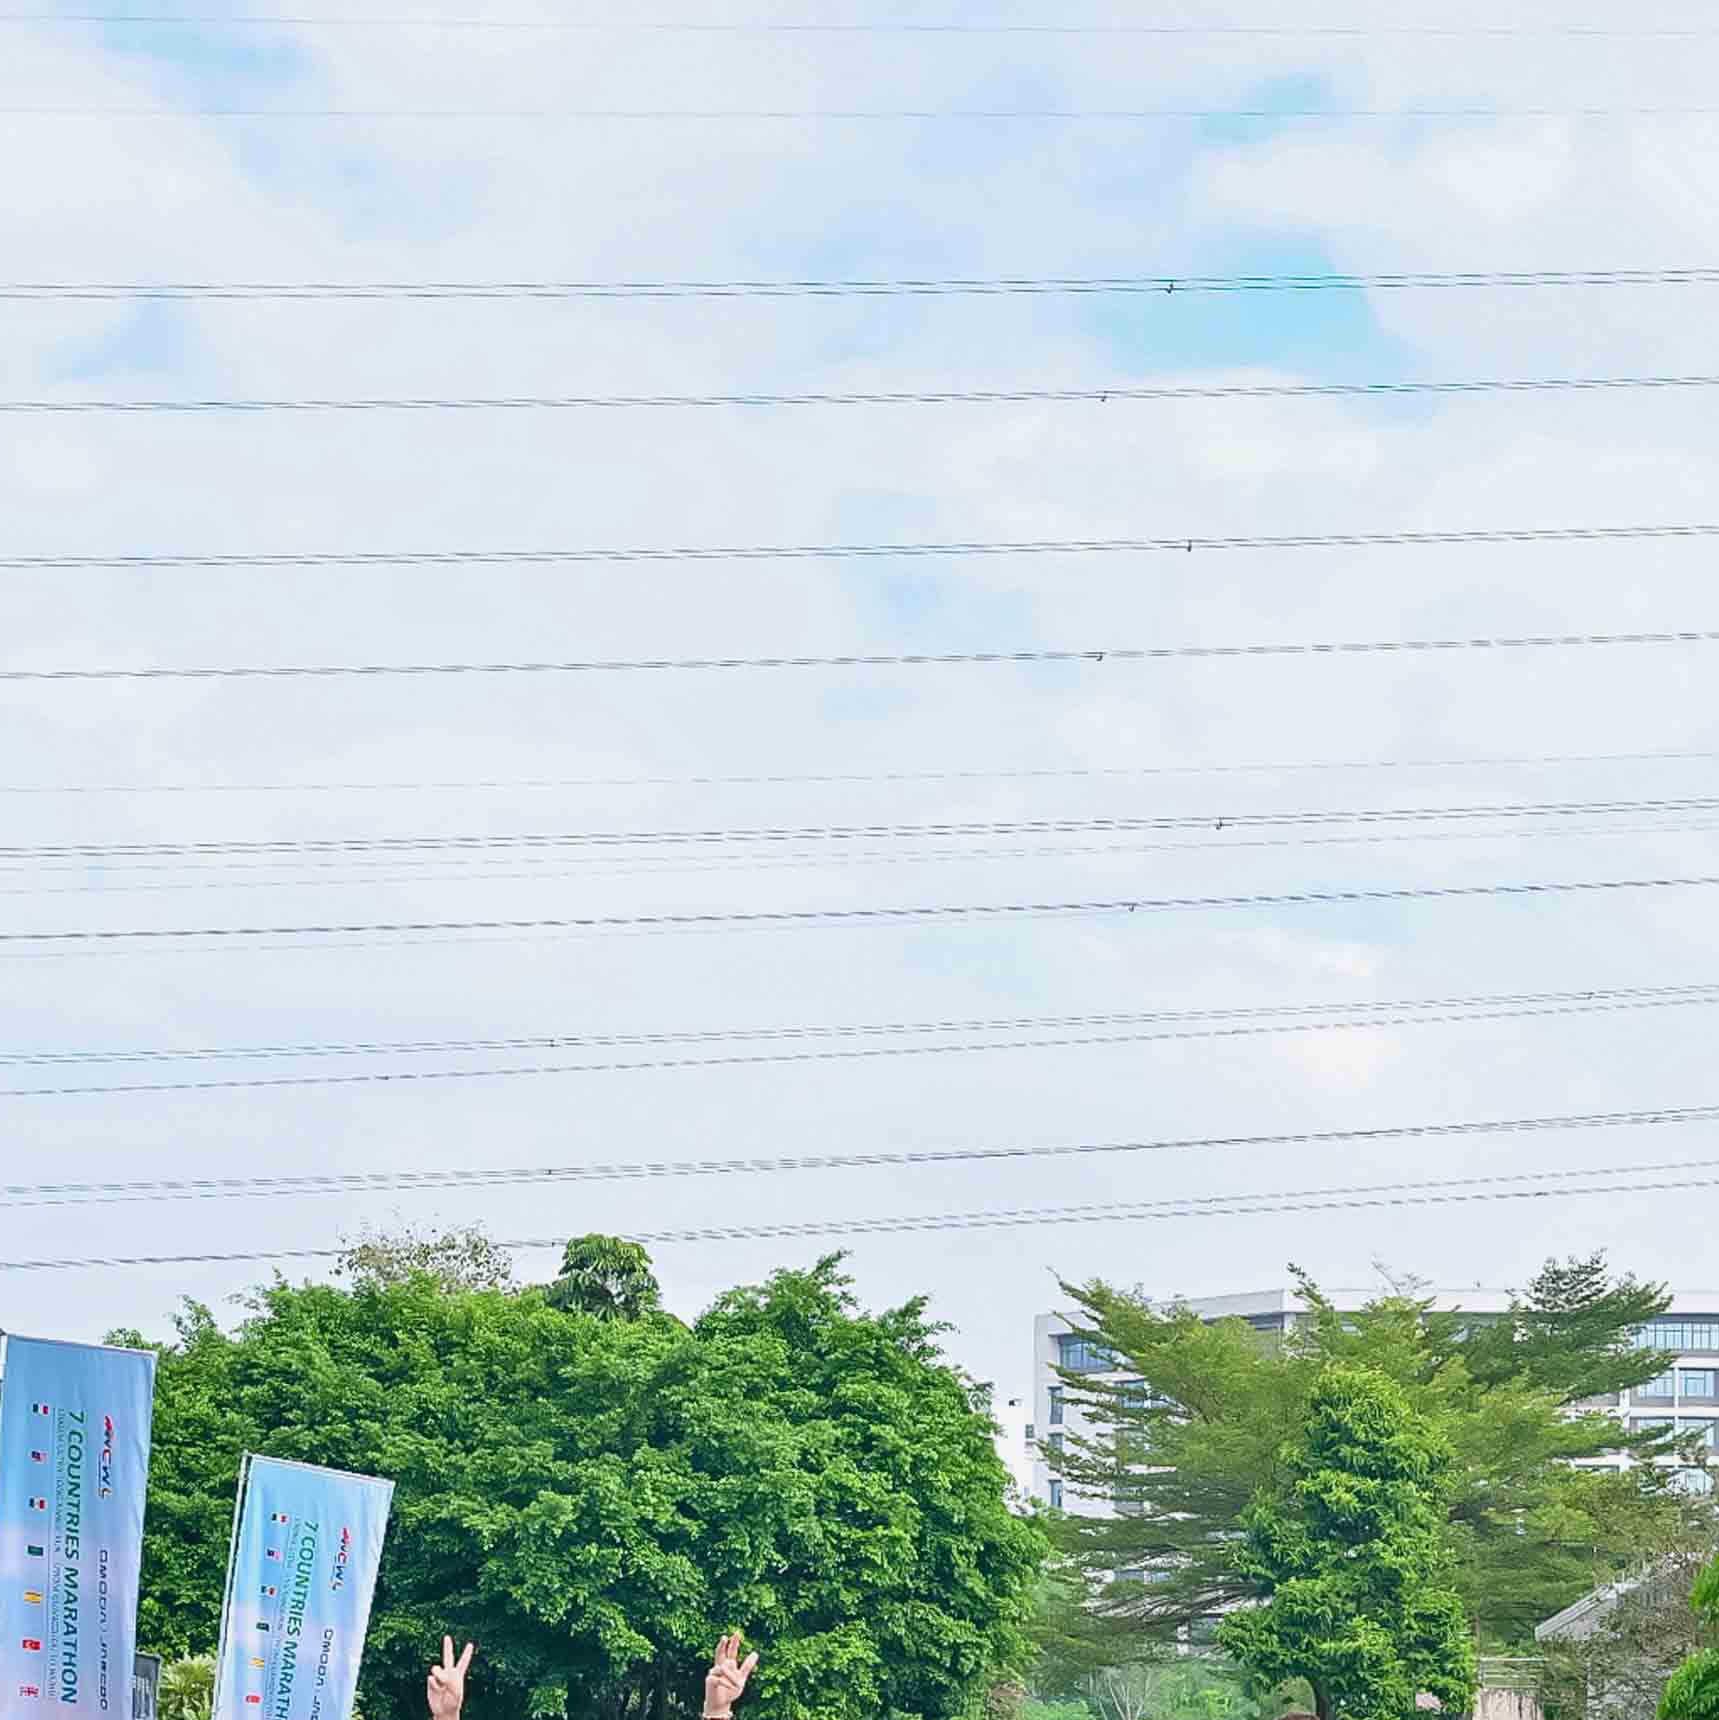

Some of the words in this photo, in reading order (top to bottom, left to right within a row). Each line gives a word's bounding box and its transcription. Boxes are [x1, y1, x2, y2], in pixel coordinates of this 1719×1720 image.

[69, 1410, 84, 1425] 7
[64, 1432, 84, 1561] COUNTRIES
[305, 1523, 319, 1534] 7
[59, 1567, 80, 1705] MARATHON
[287, 1536, 316, 1639] COUNTRIES
